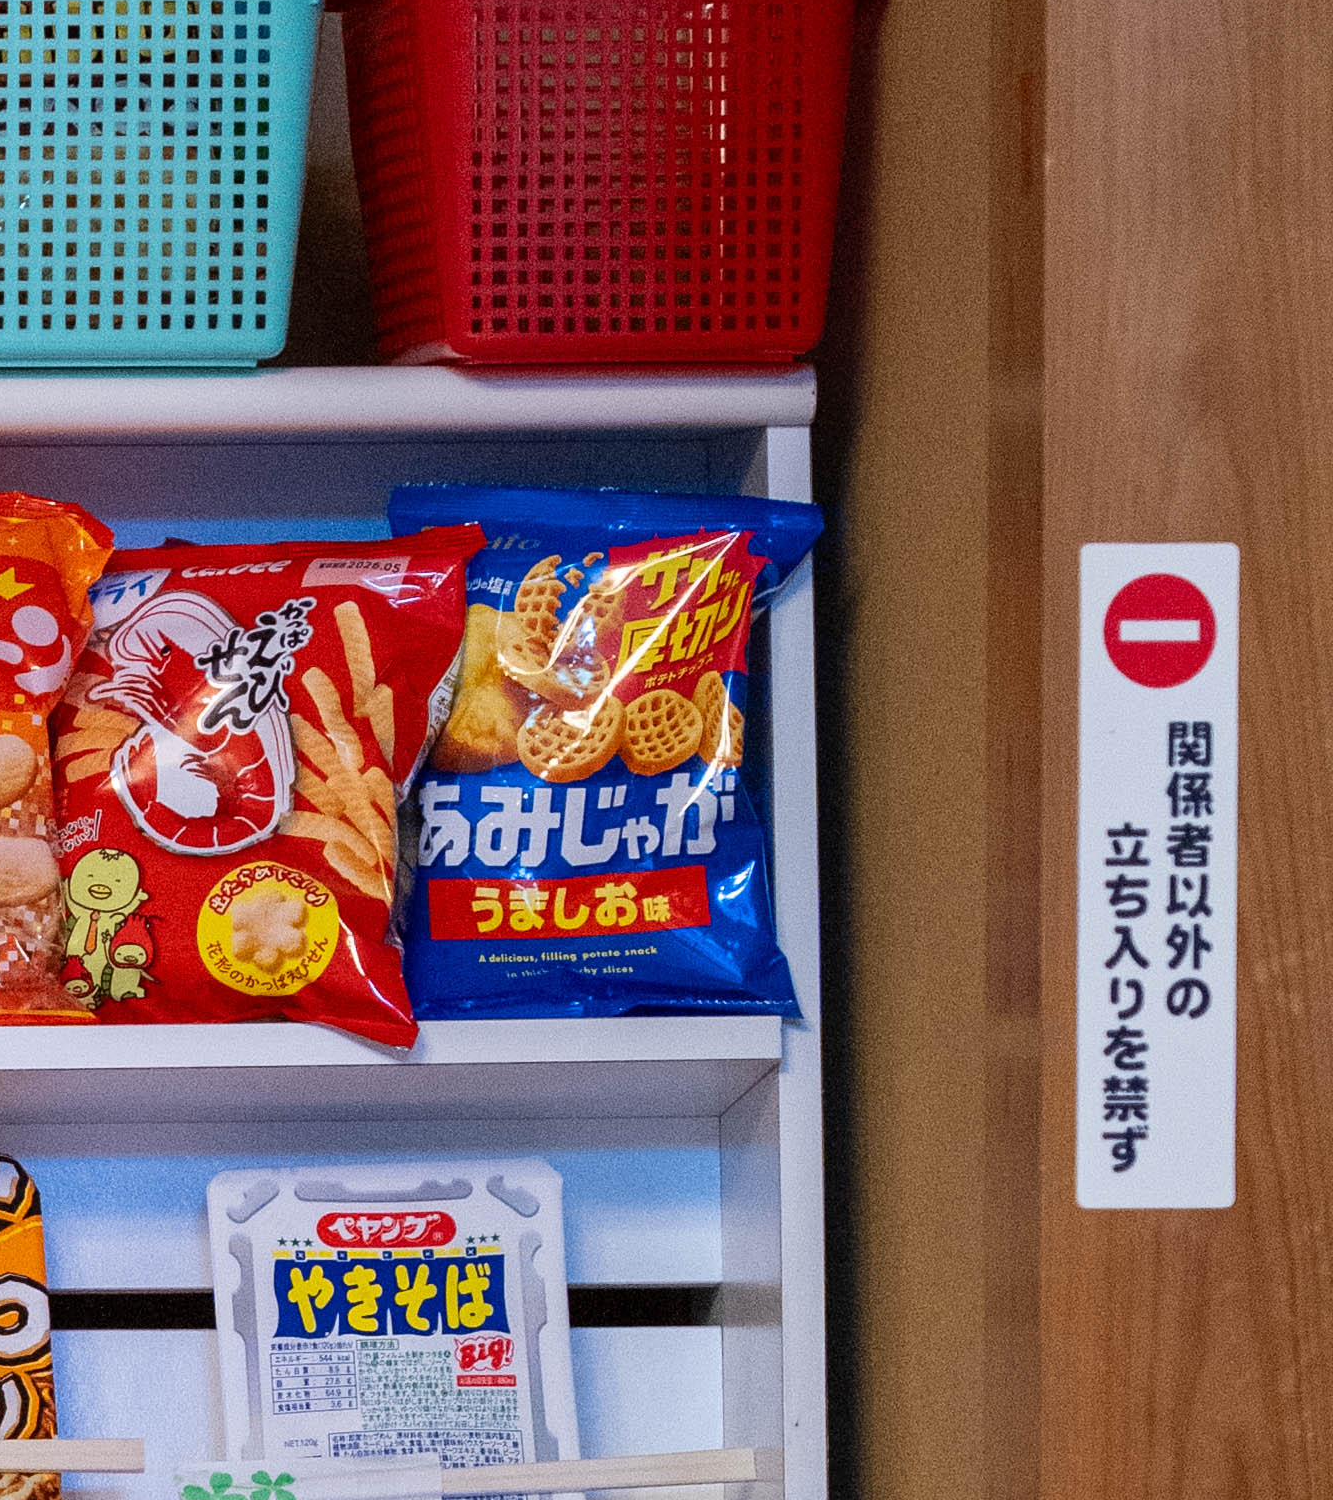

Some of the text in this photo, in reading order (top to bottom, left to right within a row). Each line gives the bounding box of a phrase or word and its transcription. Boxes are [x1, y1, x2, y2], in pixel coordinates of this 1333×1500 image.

[346, 562, 400, 573] 2026.05
[617, 581, 748, 674] 厚切り
[645, 654, 714, 688] ポテトチップス
[1166, 720, 1214, 1021] 関係者以外の
[471, 882, 670, 933] うましお味
[207, 938, 328, 990] 花形のかっぱえびせん
[489, 954, 538, 963] delicious,
[541, 952, 577, 961] filling
[582, 950, 620, 959] potato
[625, 946, 657, 956] snack
[1103, 823, 1150, 1175] 立ち入りを禁ず
[327, 1214, 439, 1242] ペヤング
[288, 1262, 494, 1333] やきそば
